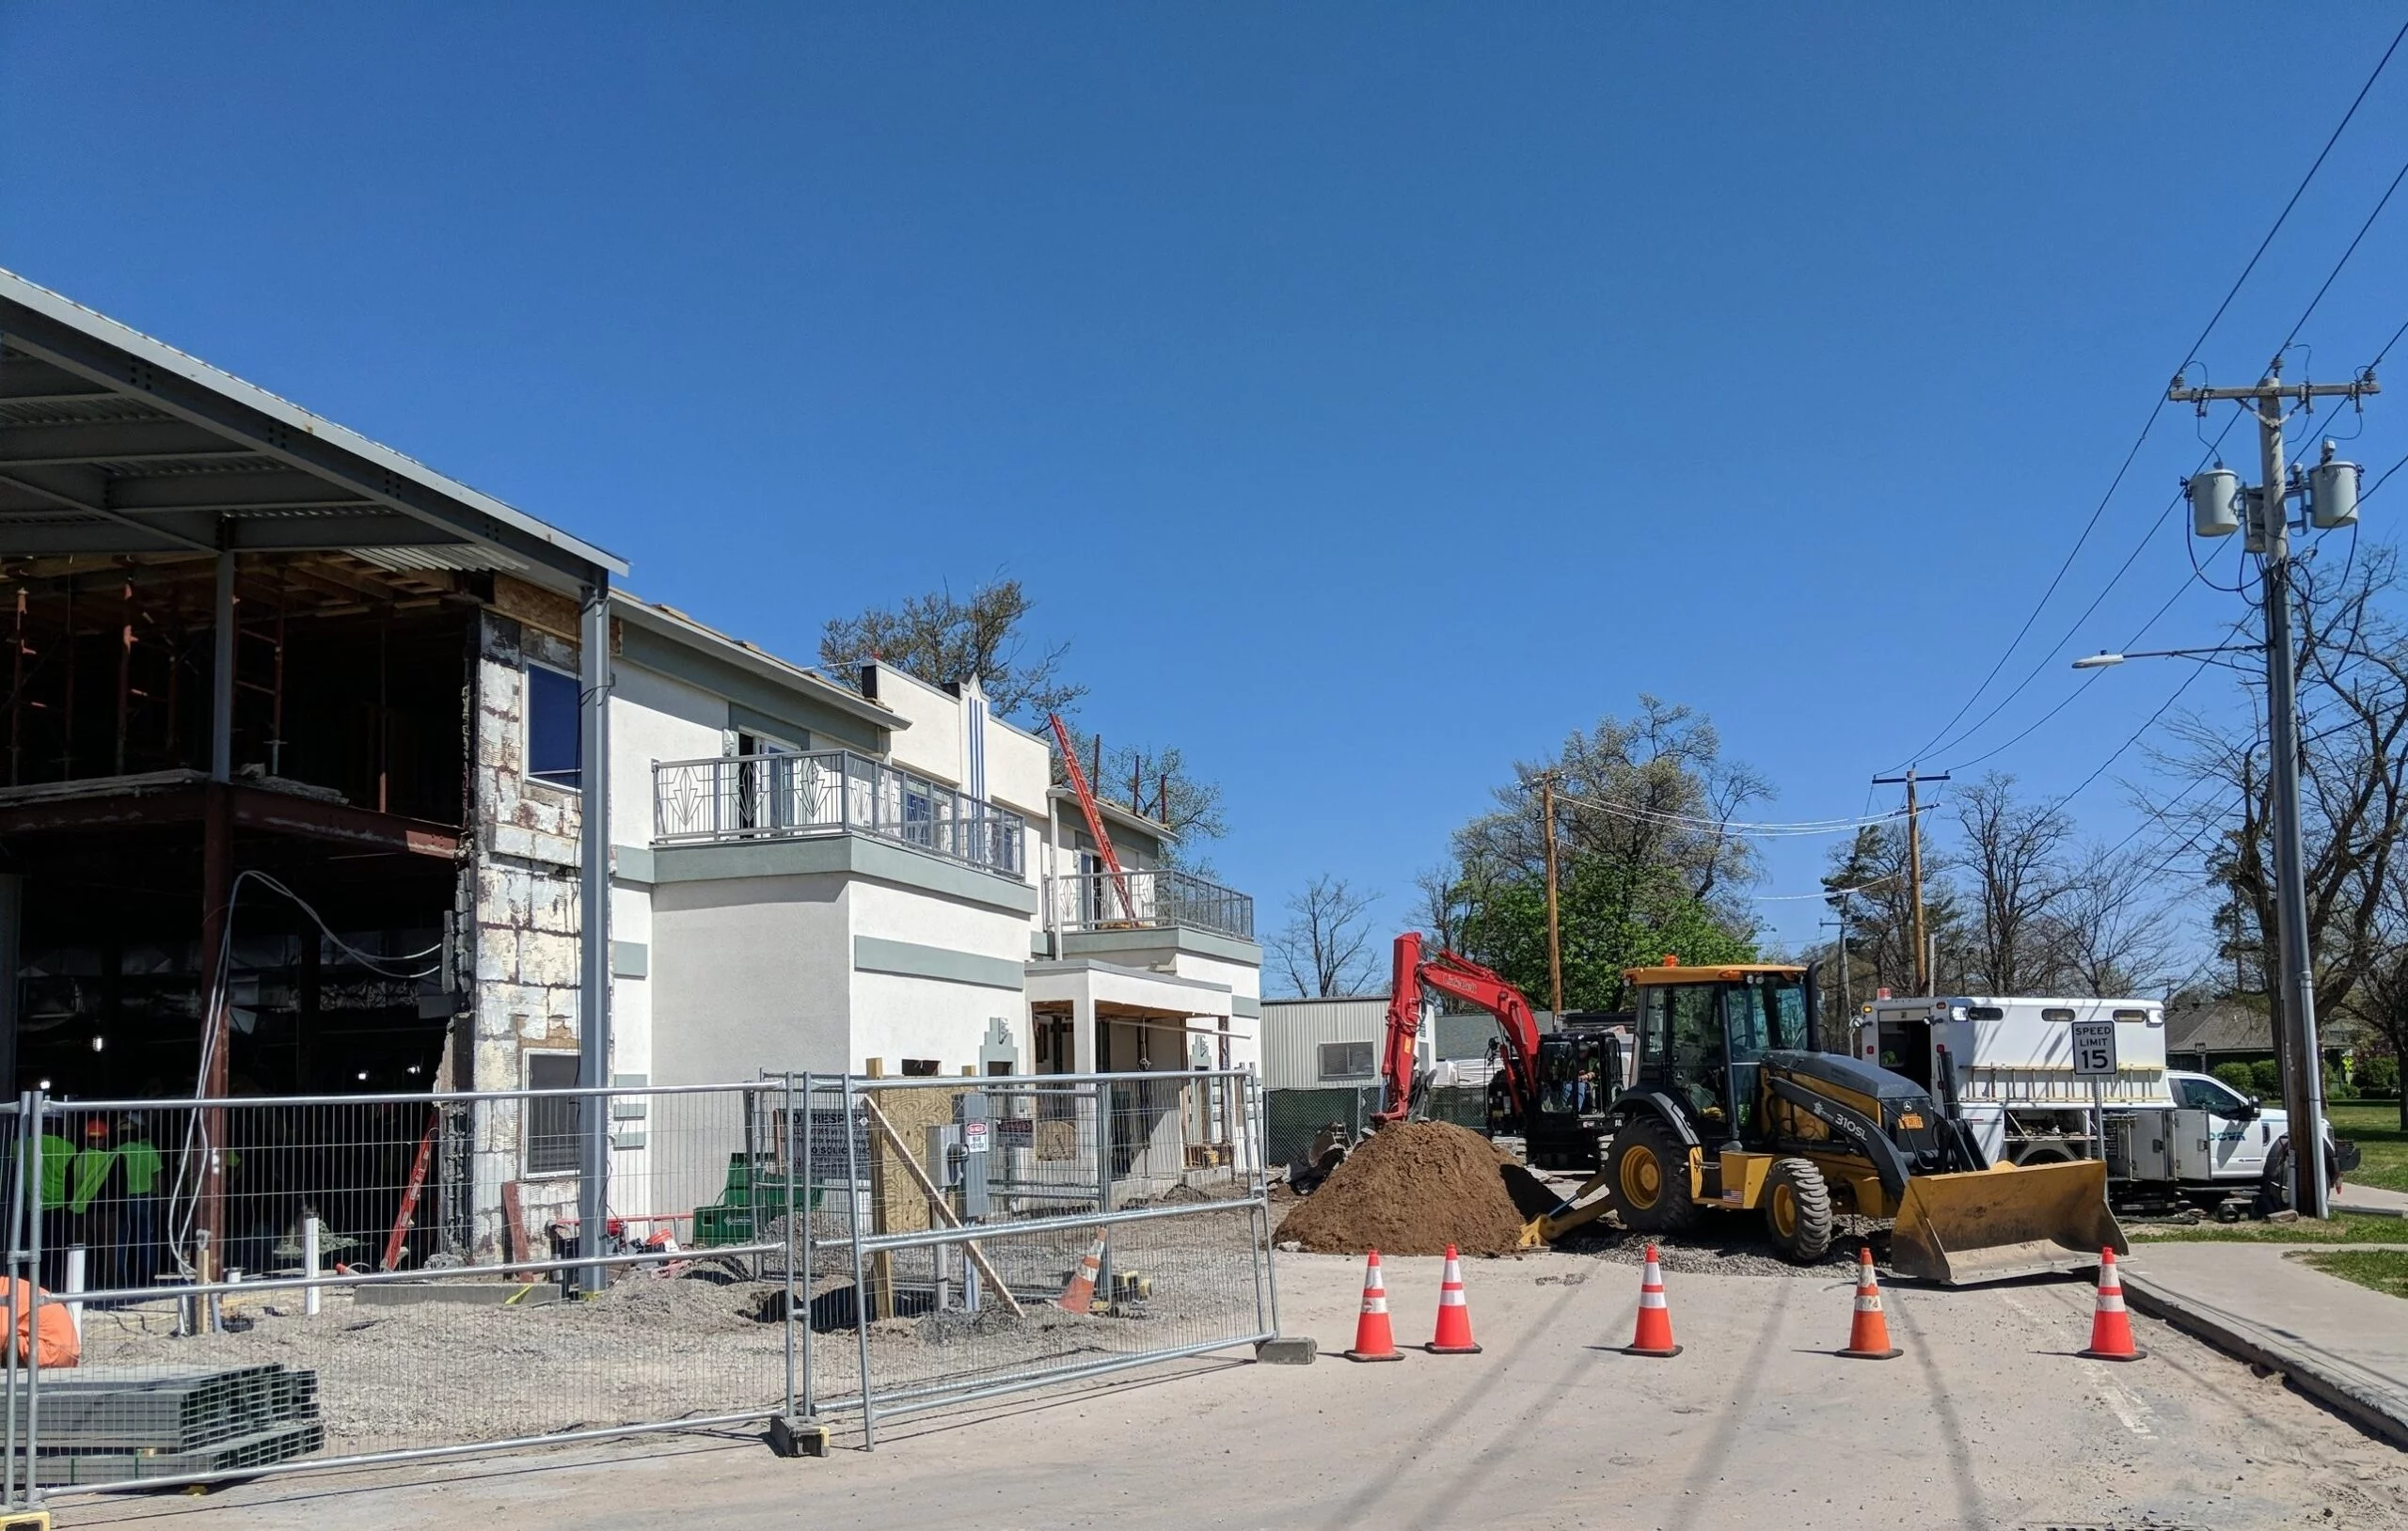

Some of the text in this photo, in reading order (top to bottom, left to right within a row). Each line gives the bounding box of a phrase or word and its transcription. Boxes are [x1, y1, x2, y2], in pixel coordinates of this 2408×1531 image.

[2075, 1026, 2112, 1035] SPEED
[2080, 1038, 2107, 1047] LIMIT
[2082, 1050, 2108, 1069] 15
[1835, 1113, 1868, 1142] 310SL
